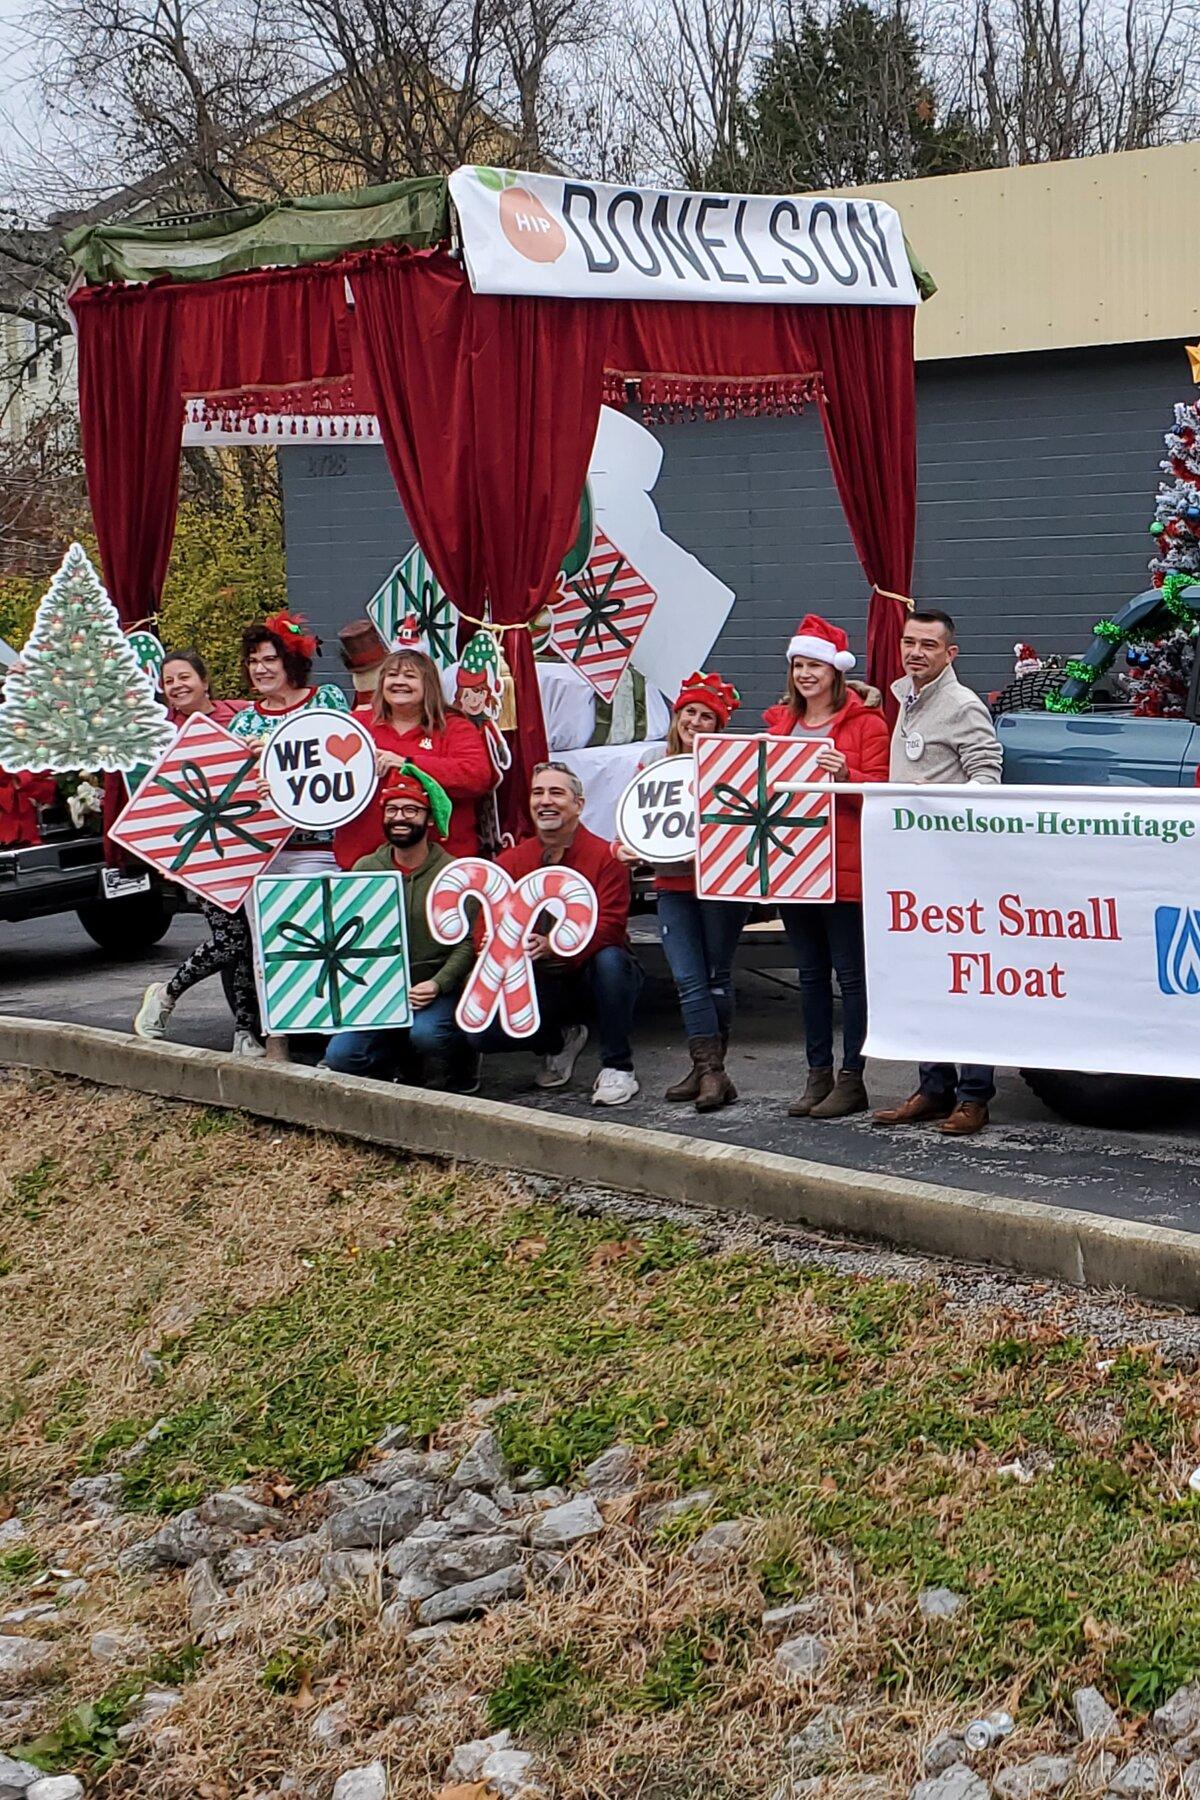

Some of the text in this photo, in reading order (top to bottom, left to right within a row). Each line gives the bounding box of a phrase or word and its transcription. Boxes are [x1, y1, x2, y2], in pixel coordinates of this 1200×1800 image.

[516, 212, 551, 234] HIP
[562, 183, 898, 288] DONELSON
[273, 738, 322, 772] WE
[286, 771, 355, 806] YOU
[637, 780, 684, 809] WE
[891, 808, 1195, 843] Donelson-Hermitage
[887, 890, 1122, 941] Best Small
[948, 952, 1066, 998] Float
